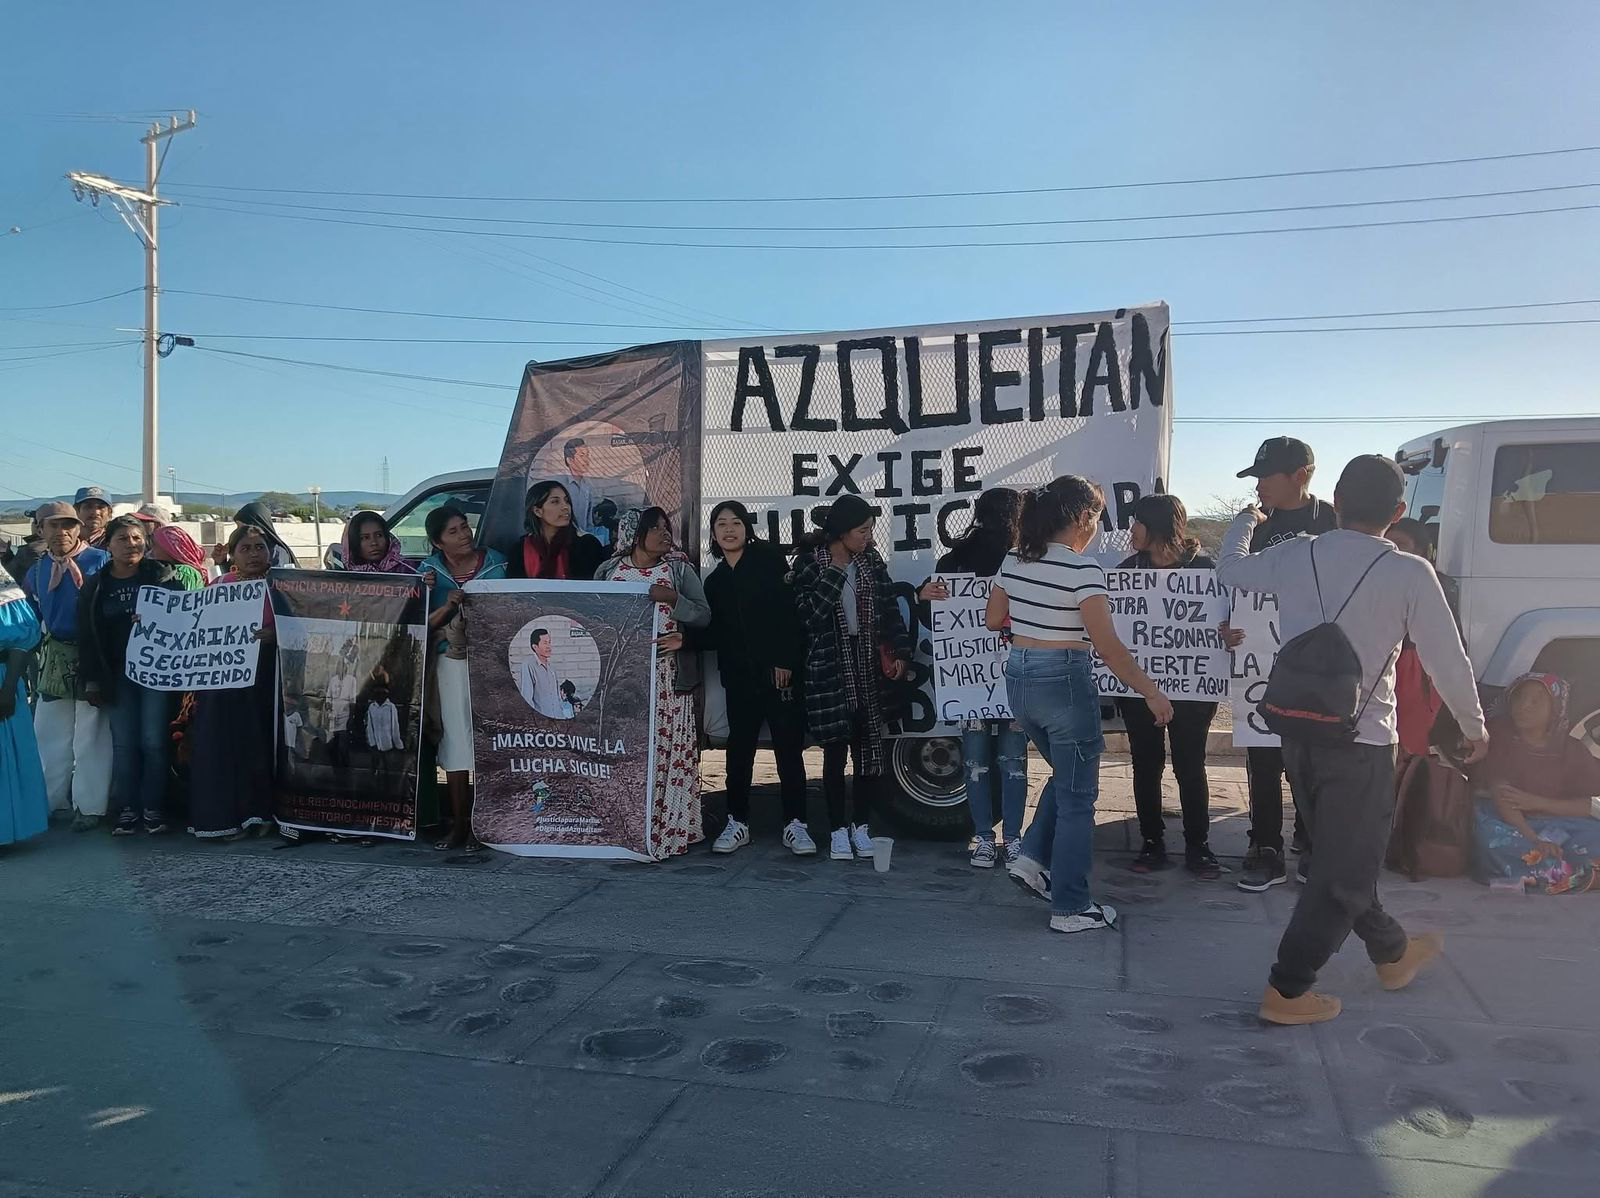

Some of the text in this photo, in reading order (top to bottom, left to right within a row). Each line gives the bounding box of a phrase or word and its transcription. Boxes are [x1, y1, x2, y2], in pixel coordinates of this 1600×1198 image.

[792, 446, 984, 497] EXIGE
[271, 579, 317, 593] JUSTICIA
[320, 580, 350, 594] PARA
[1104, 572, 1157, 591] EREN
[141, 582, 264, 613] TEPEHUANOS
[192, 609, 204, 629] Y
[1162, 598, 1208, 622] VOZ
[138, 646, 247, 671] SEGUIMOS
[934, 636, 1008, 661] JUSTICIA
[128, 661, 252, 687] RESISTIENDO
[1130, 649, 1209, 675] ERTE
[1230, 650, 1260, 679] LA
[985, 683, 996, 701] Y
[1151, 677, 1190, 693] MPRE
[1196, 677, 1229, 696] AQUI
[492, 733, 626, 755] ¡MARCOS VIVE, LA
[510, 758, 611, 779] LUCHA SIGUE!
